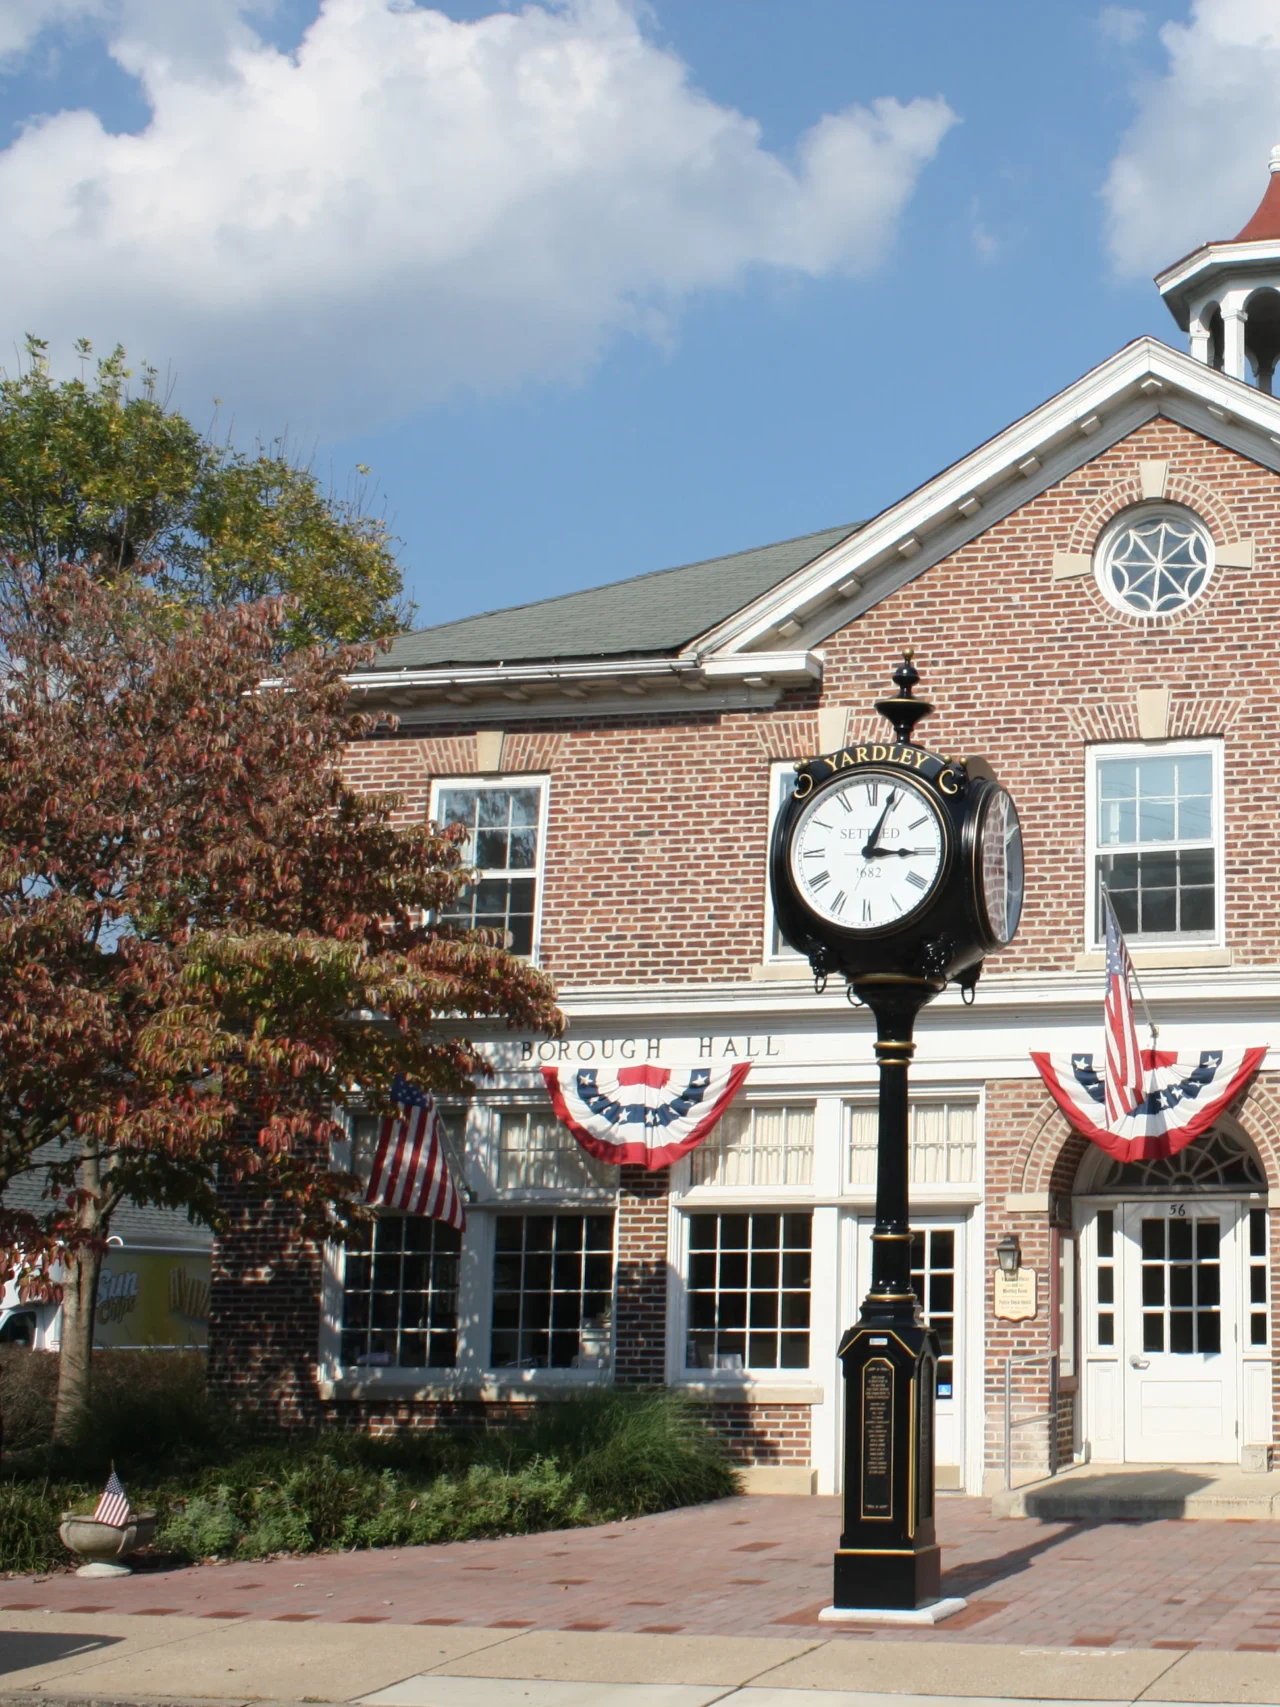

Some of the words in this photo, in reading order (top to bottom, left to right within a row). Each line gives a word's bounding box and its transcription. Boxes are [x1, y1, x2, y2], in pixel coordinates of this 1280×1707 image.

[824, 745, 930, 772] YARDLEY
[840, 828, 900, 840] SETTED
[521, 1038, 660, 1061] BOROUGH
[699, 1036, 780, 1058] HALL
[1169, 1203, 1186, 1217] 56
[96, 1268, 140, 1308] Sun
